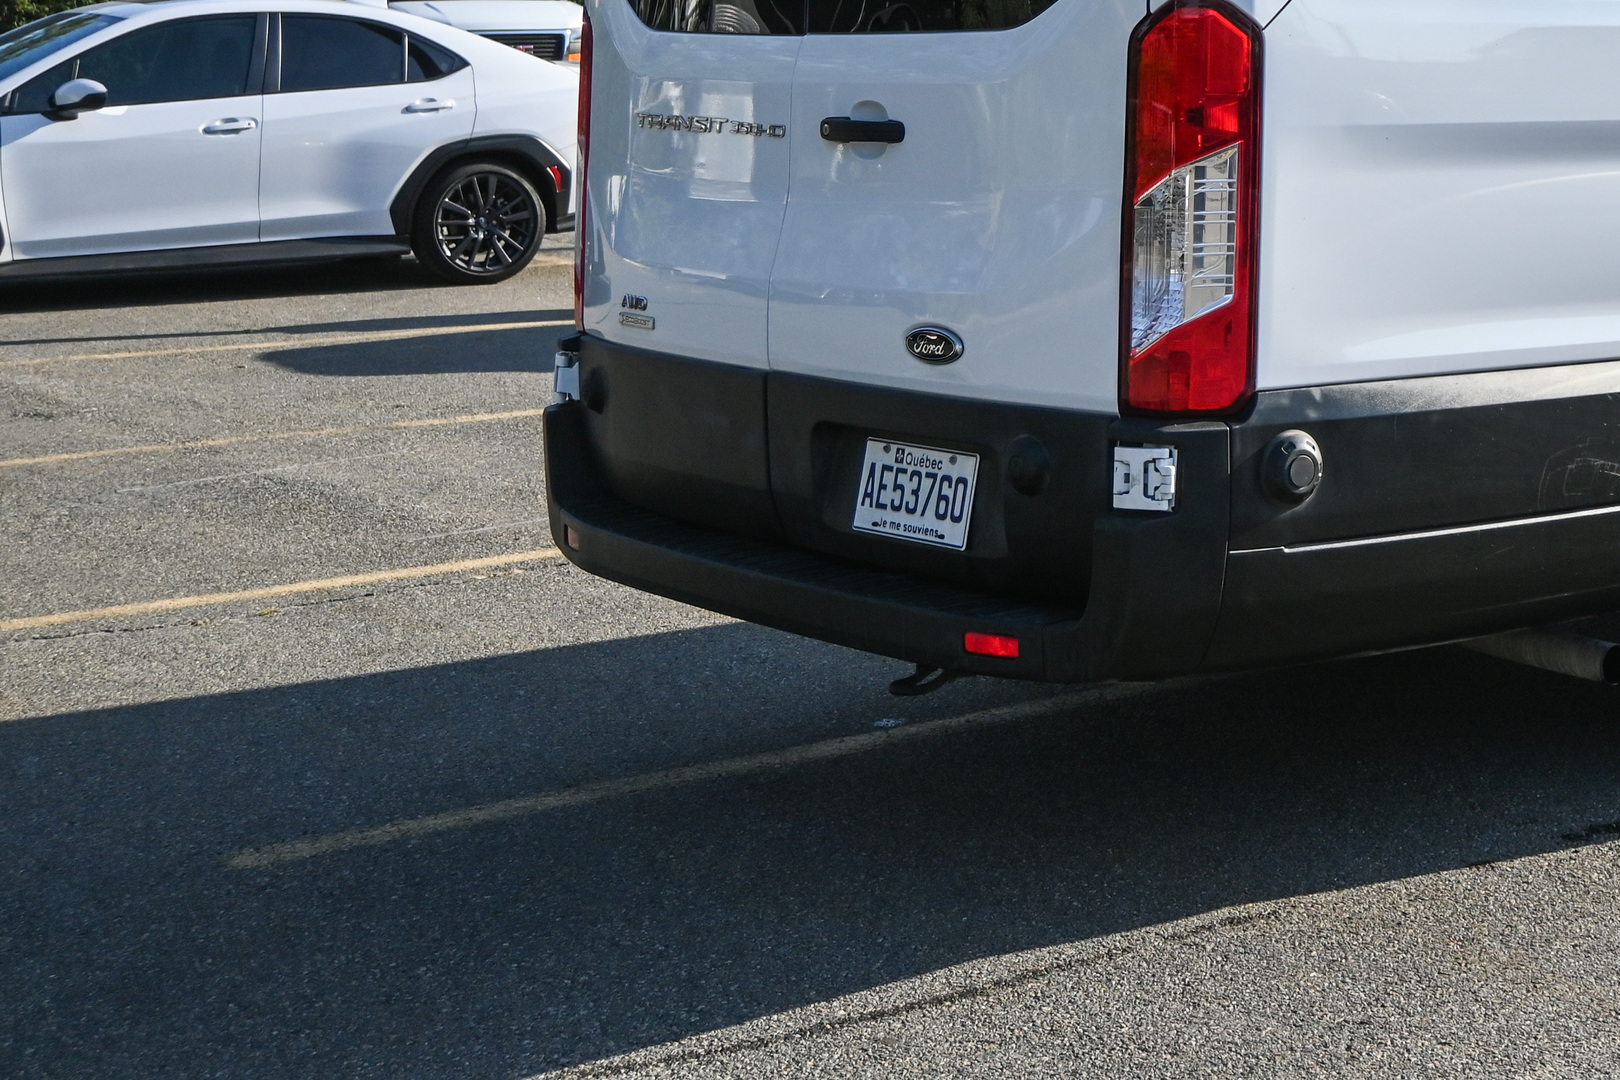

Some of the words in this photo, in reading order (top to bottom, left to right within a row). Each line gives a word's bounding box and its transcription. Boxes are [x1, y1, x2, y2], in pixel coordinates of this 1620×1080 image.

[636, 112, 729, 134] TRANSIT
[913, 333, 946, 355] Ford
[905, 452, 943, 470] Québec
[860, 462, 968, 524] AE53760
[879, 517, 888, 528] Je
[889, 520, 901, 531] me
[903, 523, 939, 537] souviens
